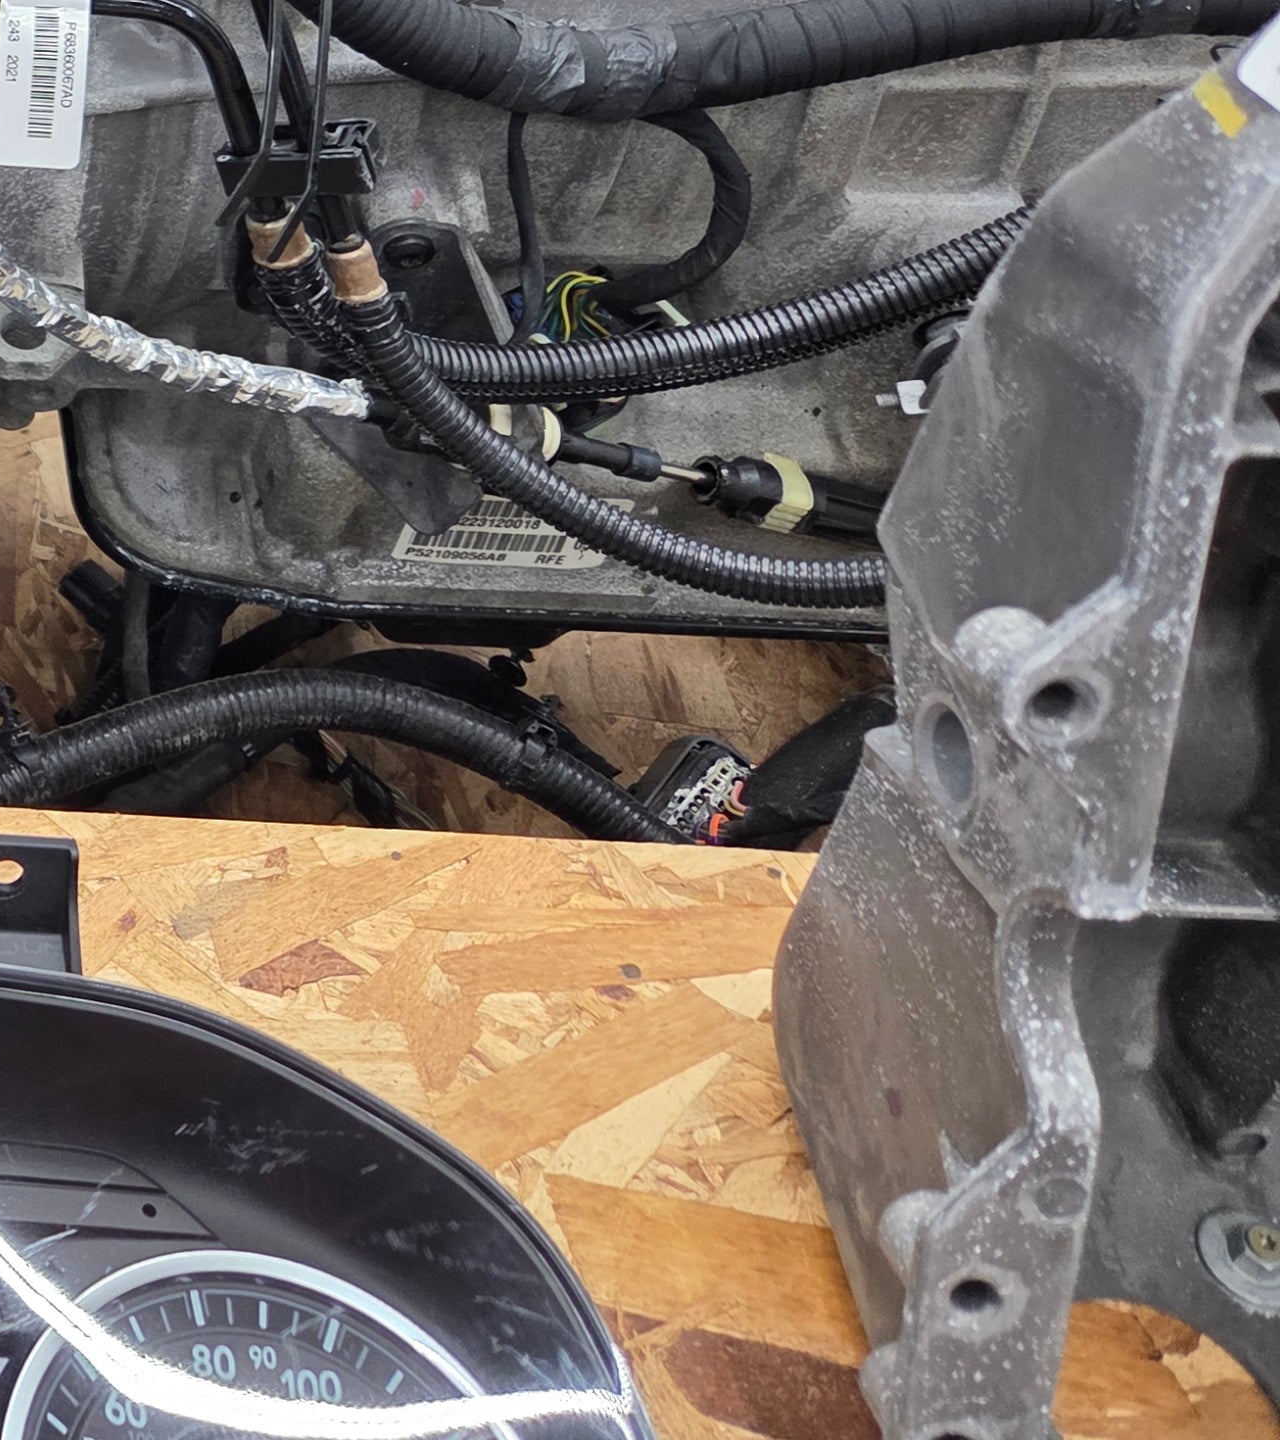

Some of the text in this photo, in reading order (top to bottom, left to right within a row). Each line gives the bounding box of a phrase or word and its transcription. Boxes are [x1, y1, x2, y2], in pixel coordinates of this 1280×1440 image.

[5, 19, 20, 82] 243 2021
[61, 33, 76, 108] 68360067AD
[534, 554, 566, 565] RFE
[192, 1344, 235, 1381] 80
[248, 1345, 277, 1370] 90
[280, 1368, 342, 1403] 100
